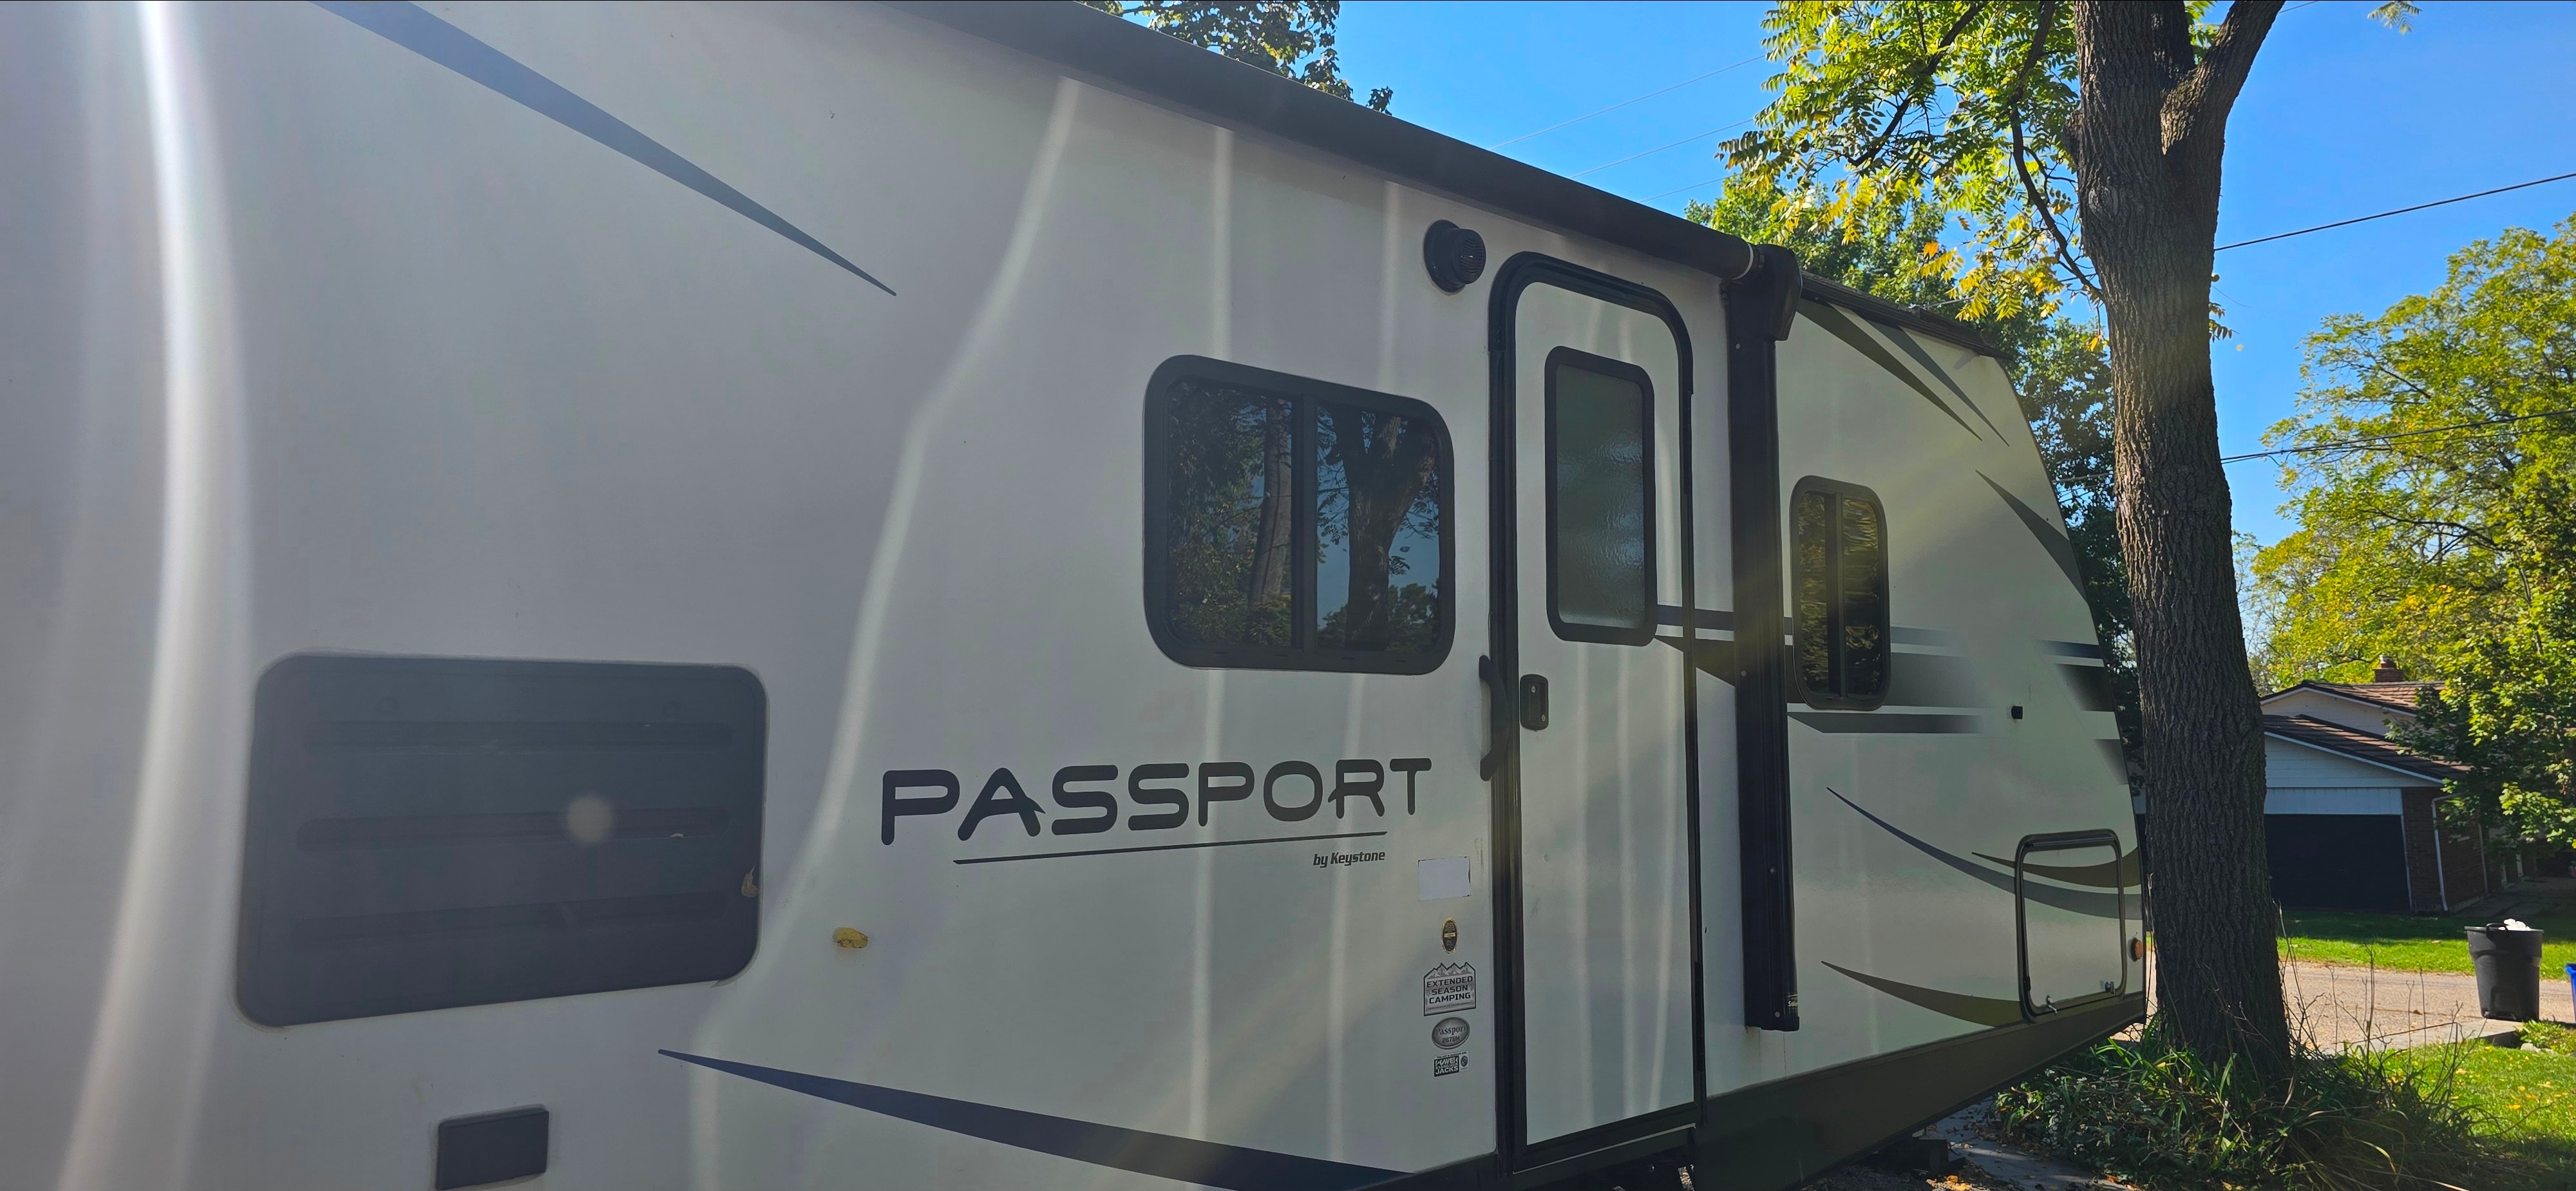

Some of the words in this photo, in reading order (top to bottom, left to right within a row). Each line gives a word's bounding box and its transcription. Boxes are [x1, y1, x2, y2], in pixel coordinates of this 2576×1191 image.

[881, 757, 1432, 846] PASSPORT
[1312, 853, 1329, 868] by
[1330, 852, 1386, 866] Keystone
[1426, 975, 1473, 988] EXTENDED
[1431, 984, 1468, 996] SEASON
[1428, 992, 1472, 1004] CAMPING
[1435, 1024, 1468, 1036] Passport
[1435, 1065, 1459, 1075] JACKS
